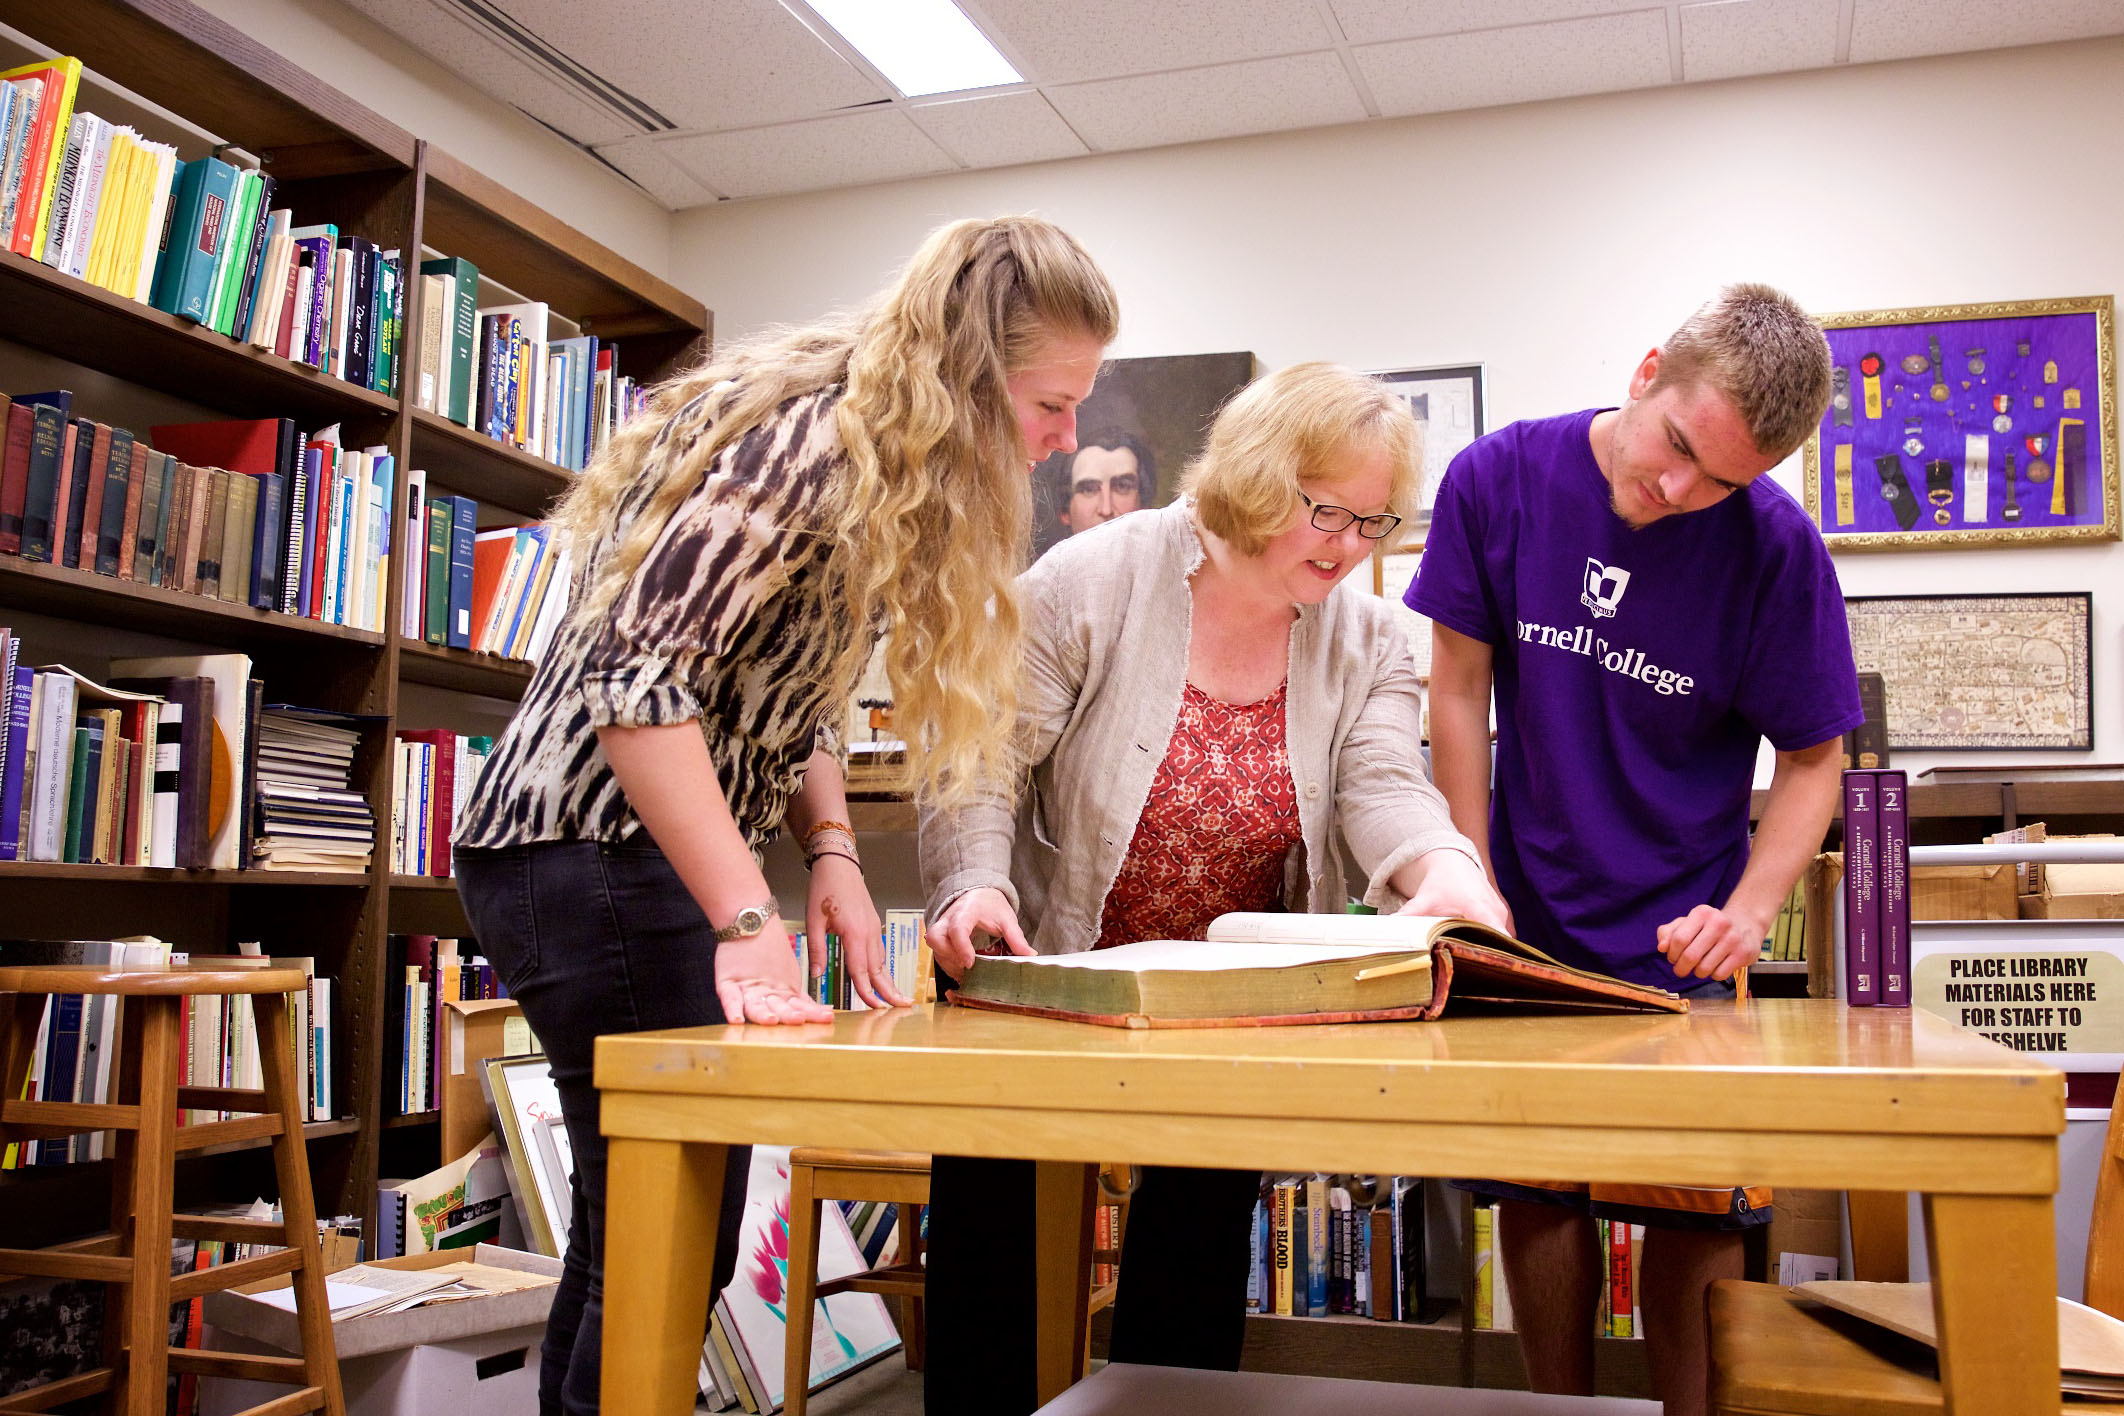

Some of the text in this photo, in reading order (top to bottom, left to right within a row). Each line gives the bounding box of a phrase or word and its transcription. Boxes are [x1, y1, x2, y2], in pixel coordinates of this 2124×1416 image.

[60, 142, 81, 193] MIDNIGHT
[49, 193, 71, 249] ECONOMIST
[315, 273, 326, 304] Organic
[312, 305, 323, 344] Chemistry
[493, 321, 498, 331] AS
[491, 355, 496, 364] AS
[1517, 619, 1695, 695] ornell College
[53, 715, 63, 746] Moderne
[49, 748, 60, 782] deutsche
[1855, 792, 1867, 807] 1
[1885, 792, 1898, 807] 2
[1860, 838, 1874, 900] Cornell College
[1892, 838, 1904, 900] Cornell College
[1950, 957, 2088, 978] PLACE LIBRARY
[1945, 982, 2097, 1002] MATERIALS HERE
[1961, 1007, 2082, 1027] FOR STAFF TO
[1312, 1207, 1323, 1251] Steinbeck
[1274, 1229, 1289, 1269] BLOOD
